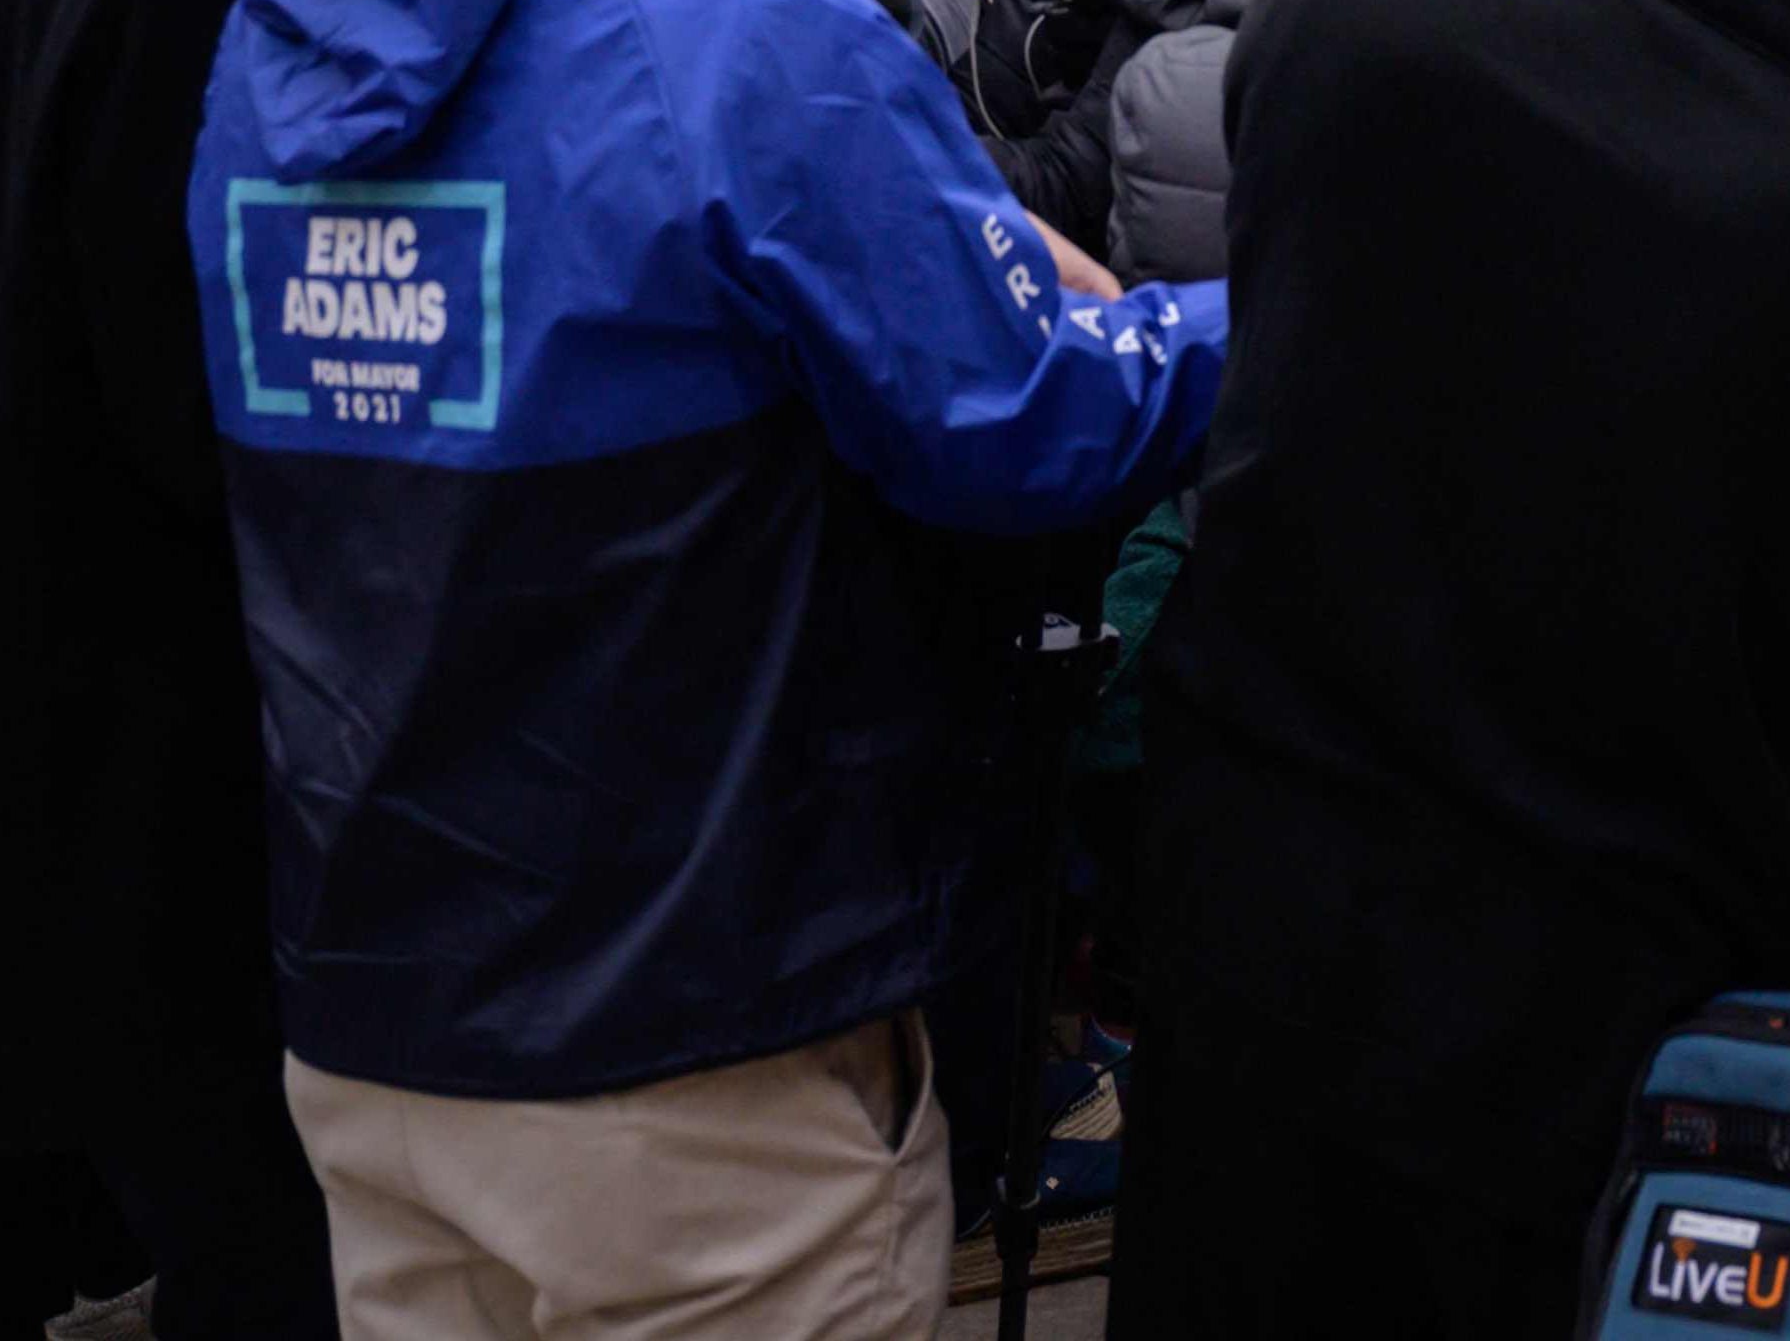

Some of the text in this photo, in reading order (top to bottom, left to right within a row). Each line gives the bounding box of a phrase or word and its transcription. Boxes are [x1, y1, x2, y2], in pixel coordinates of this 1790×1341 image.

[305, 216, 420, 279] ERIC
[281, 277, 448, 345] ADAMS
[311, 358, 422, 394] FOR MAYOR
[332, 391, 400, 424] 2021
[1648, 1239, 1790, 1310] LiveU
